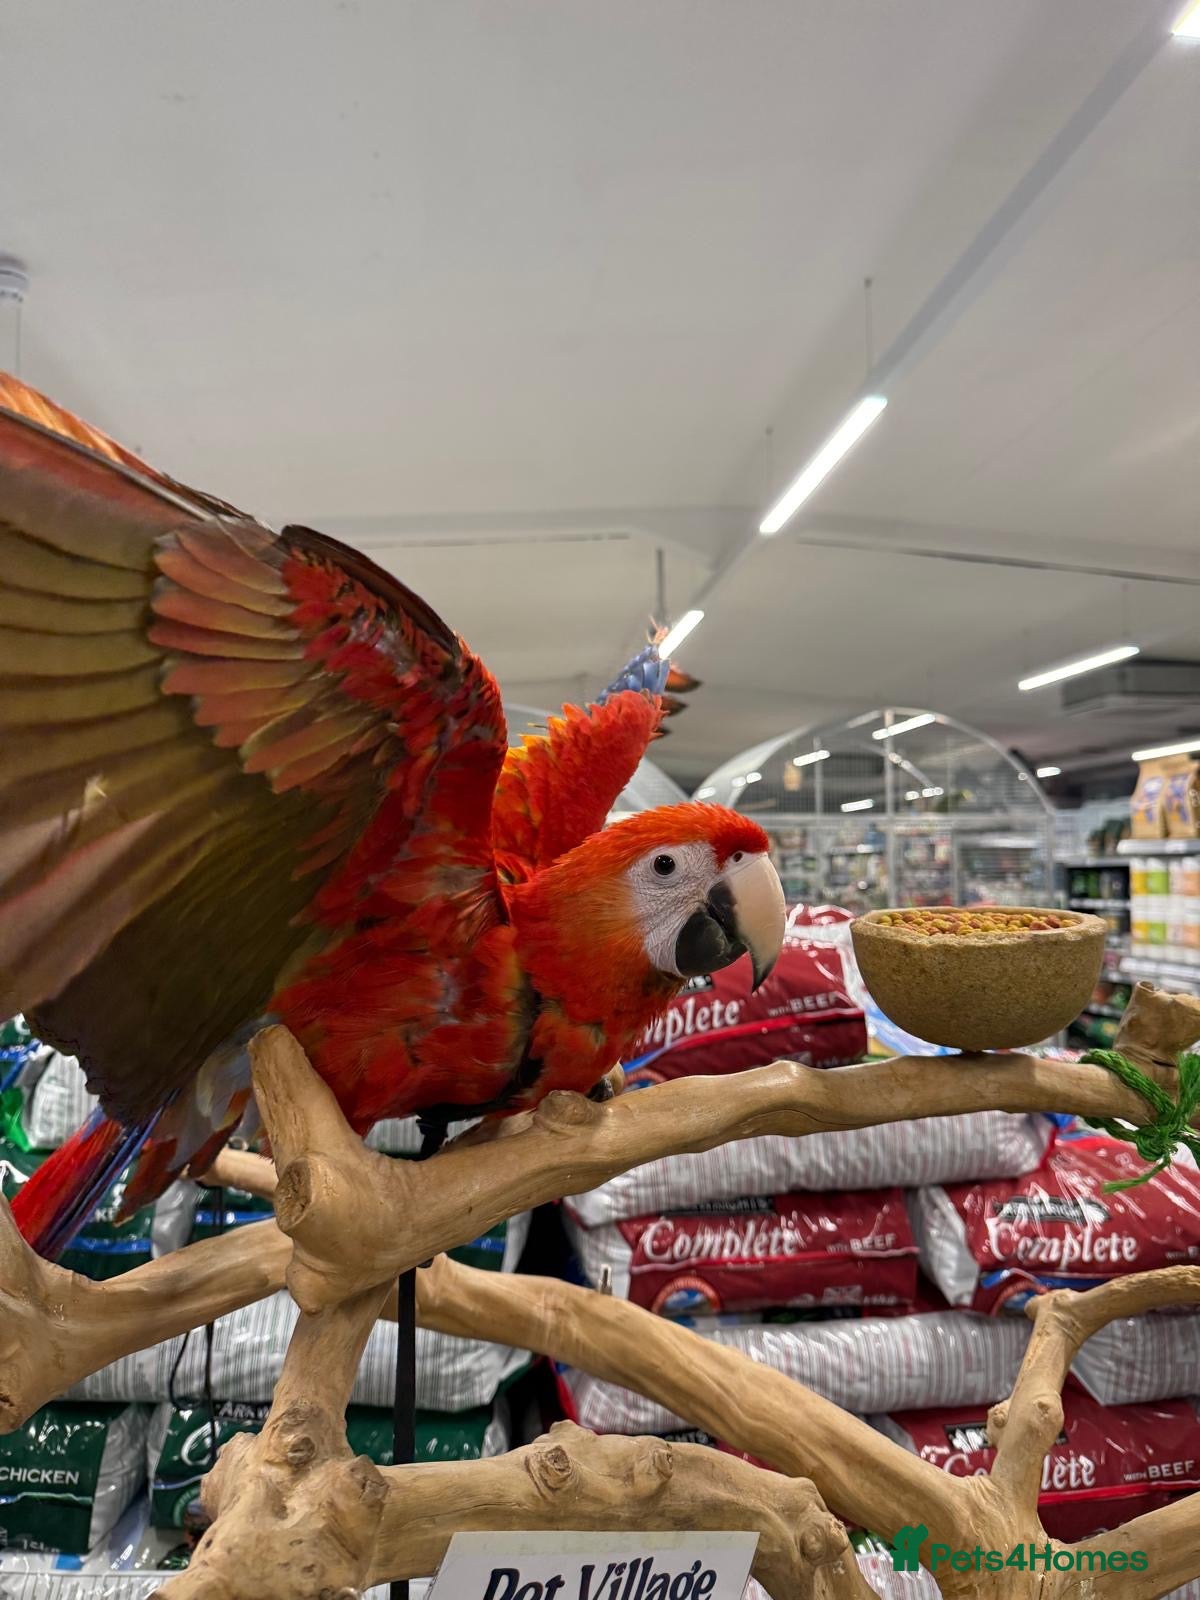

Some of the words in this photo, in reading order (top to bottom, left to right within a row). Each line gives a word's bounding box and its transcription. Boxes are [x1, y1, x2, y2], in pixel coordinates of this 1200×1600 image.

[790, 990, 837, 1013] BEEF
[643, 1216, 797, 1261] Complete
[849, 1233, 897, 1251] BEEF
[986, 1218, 1138, 1271] Complete
[0, 1466, 80, 1485] CHICKEN
[1148, 1460, 1195, 1479] BEEF
[579, 1556, 718, 1600] Village
